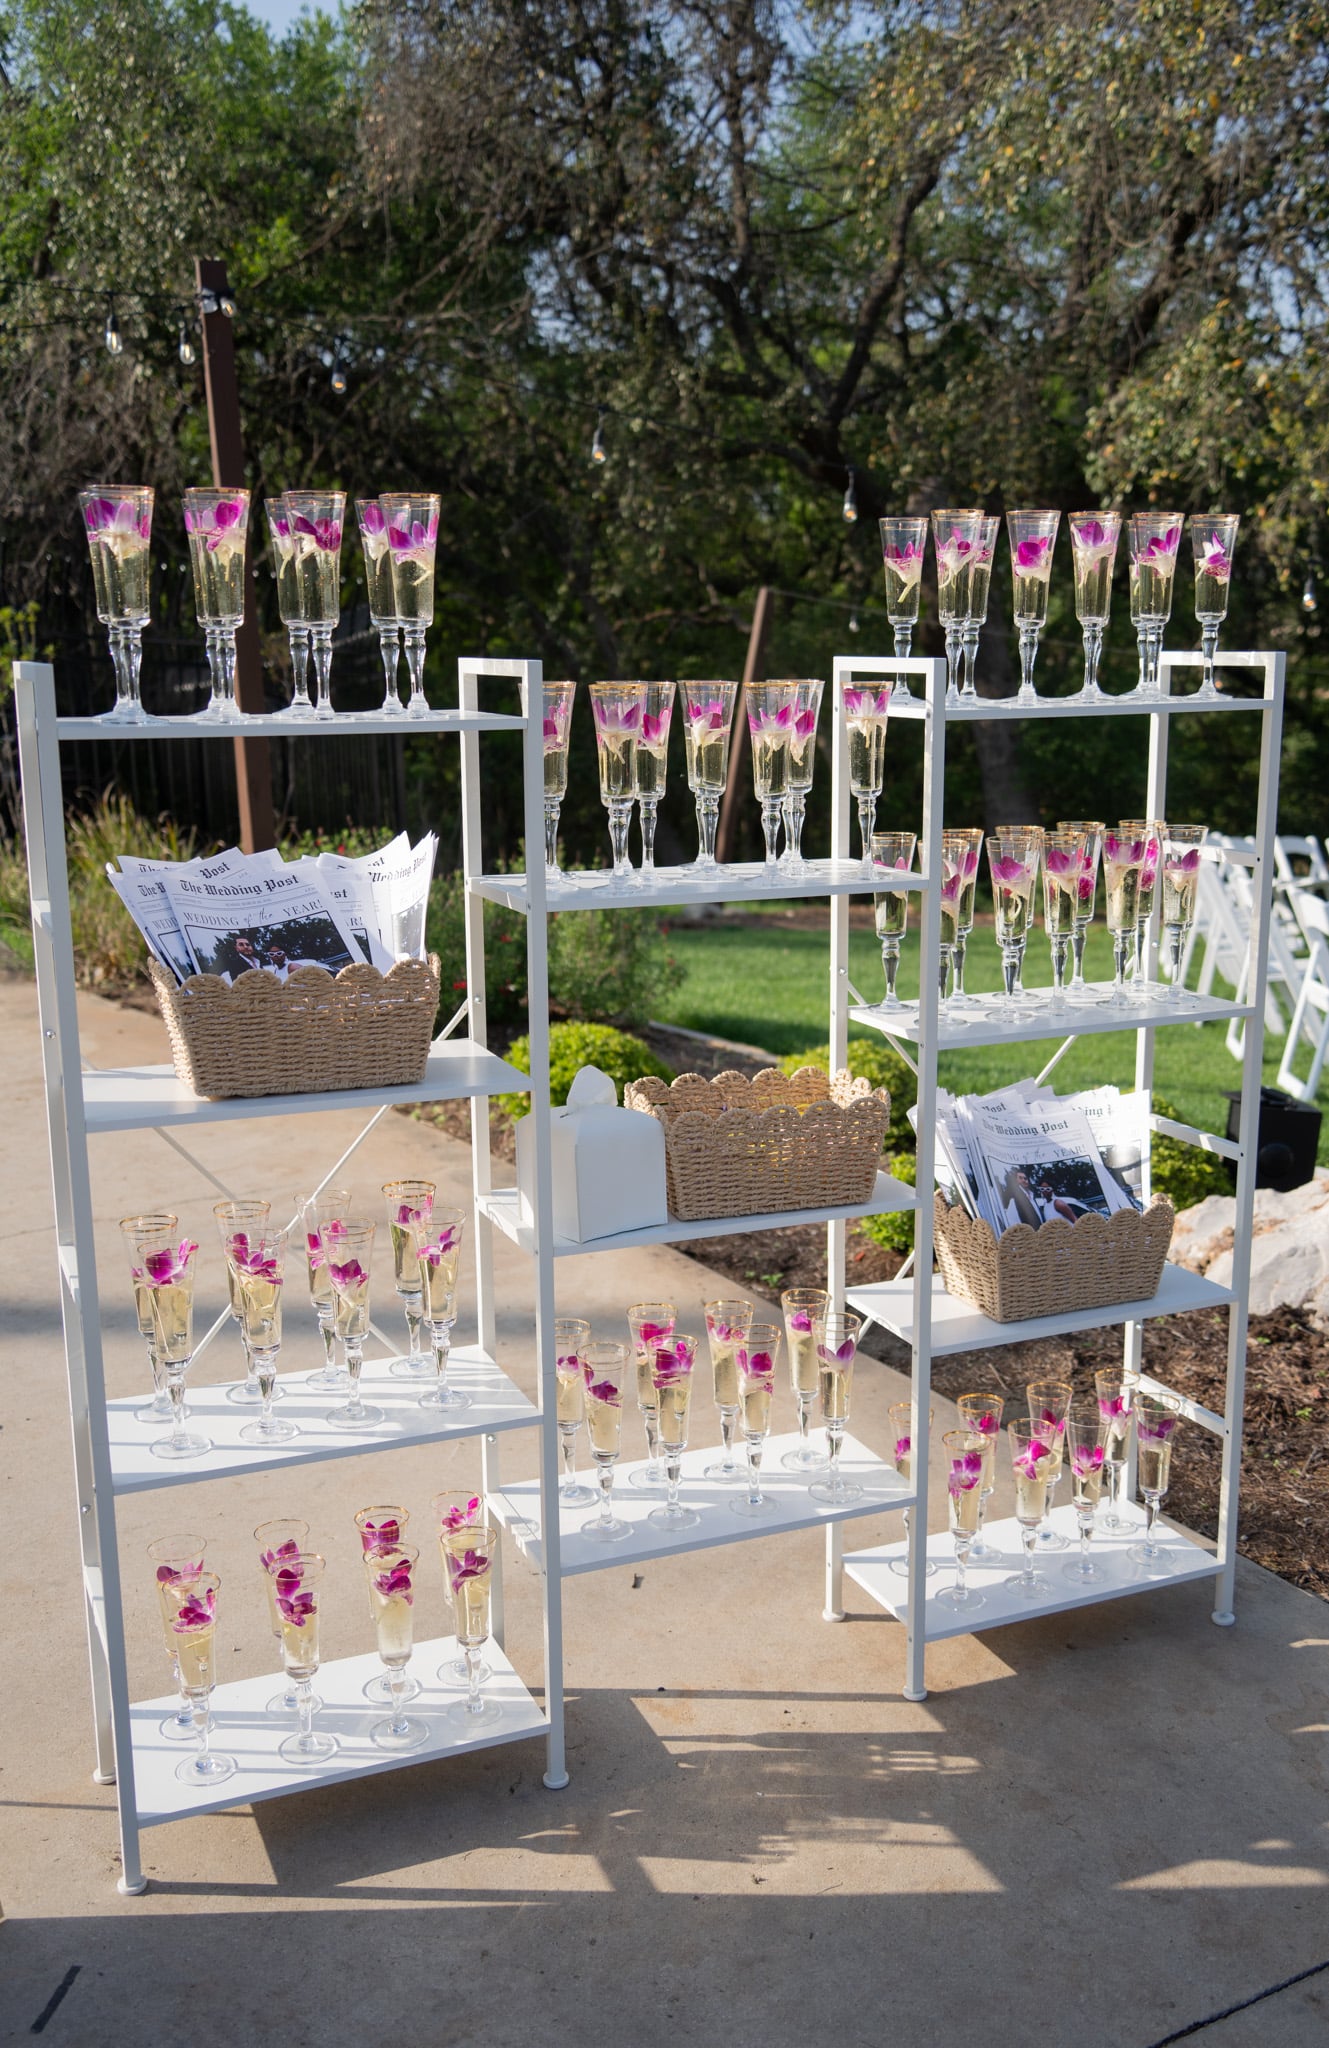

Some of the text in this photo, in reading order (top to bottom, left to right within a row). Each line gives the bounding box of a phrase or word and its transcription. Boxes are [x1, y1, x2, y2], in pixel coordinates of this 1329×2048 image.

[200, 862, 230, 879] Post
[137, 884, 157, 897] The
[179, 879, 203, 895] The
[203, 883, 262, 896] Wedding
[264, 875, 299, 892] Post
[183, 912, 239, 926] WEDDING
[282, 899, 323, 917] YEAR!
[994, 1124, 1039, 1136] Wedding
[1040, 1119, 1069, 1135] Post
[1053, 1144, 1087, 1158] YEAR!
